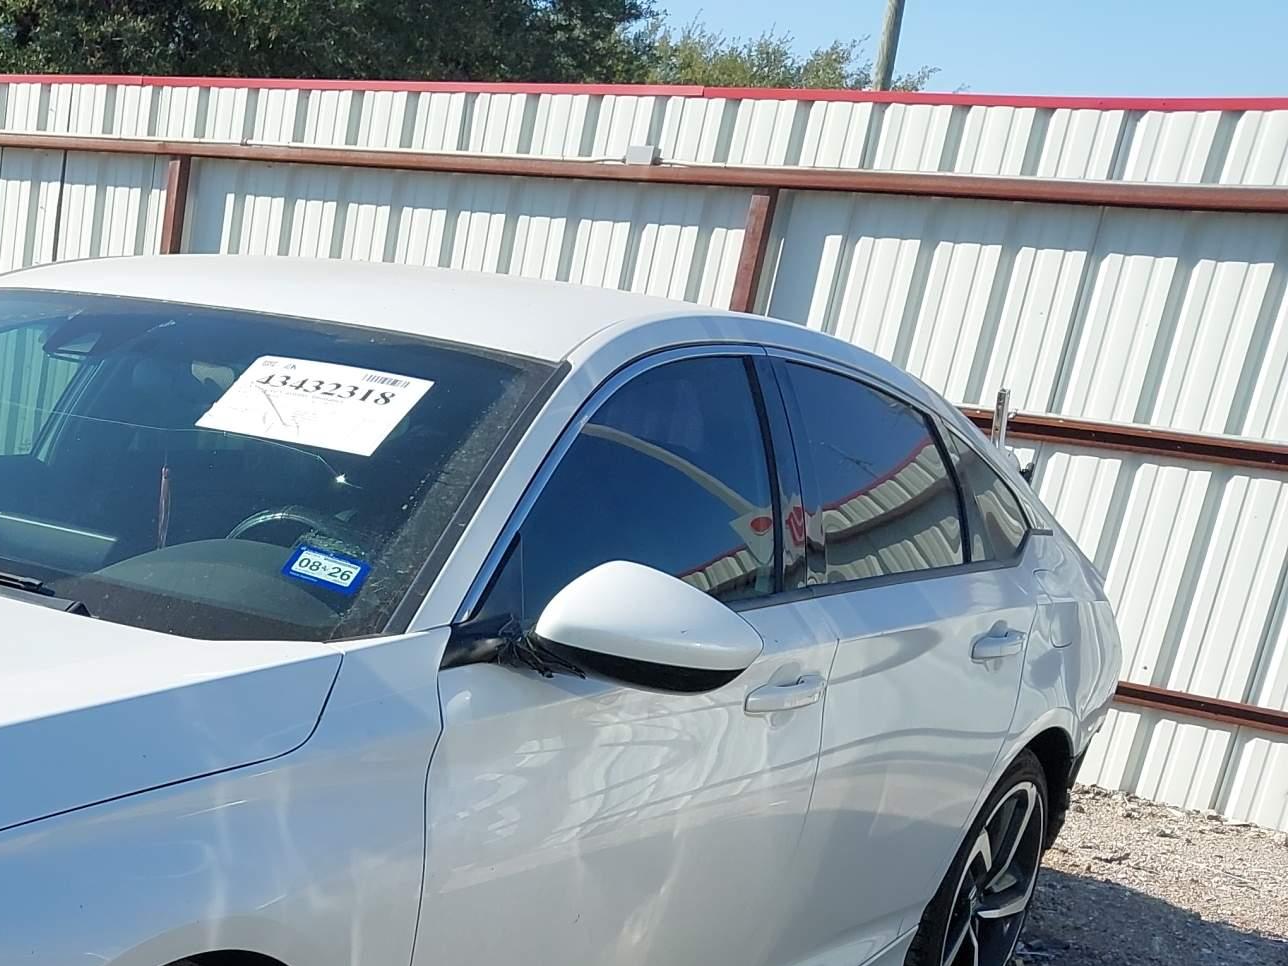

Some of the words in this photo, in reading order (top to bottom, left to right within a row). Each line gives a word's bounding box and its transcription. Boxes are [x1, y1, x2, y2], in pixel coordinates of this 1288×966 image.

[256, 373, 397, 406] 43432318
[298, 557, 322, 572] 08
[327, 566, 354, 582] 26
